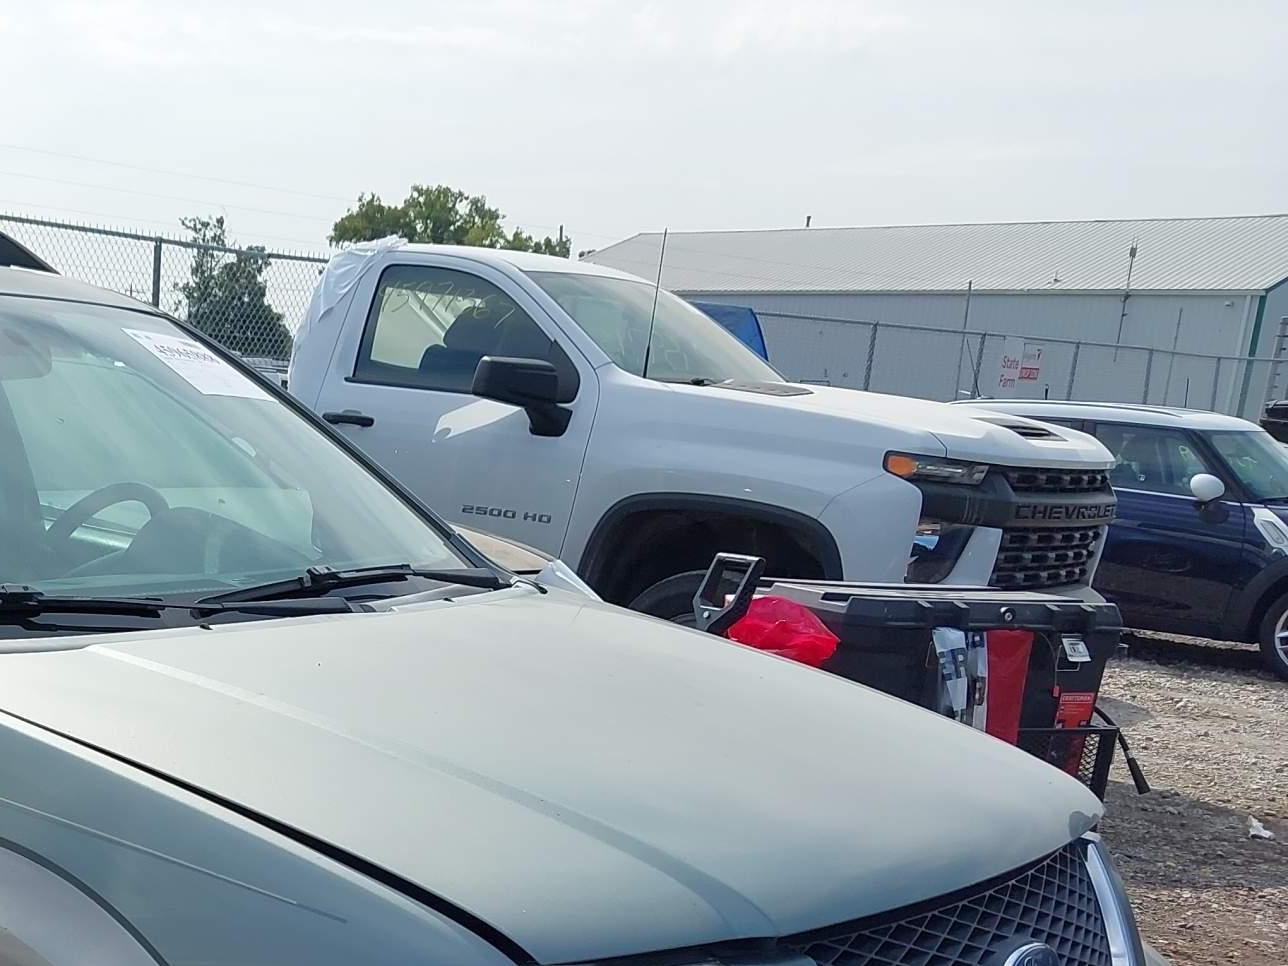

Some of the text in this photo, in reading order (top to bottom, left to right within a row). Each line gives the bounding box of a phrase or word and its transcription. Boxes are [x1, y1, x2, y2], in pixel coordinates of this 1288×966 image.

[1002, 354, 1020, 370] State
[461, 504, 552, 524] 2500 HD
[1014, 504, 1116, 520] CHEVROLET
